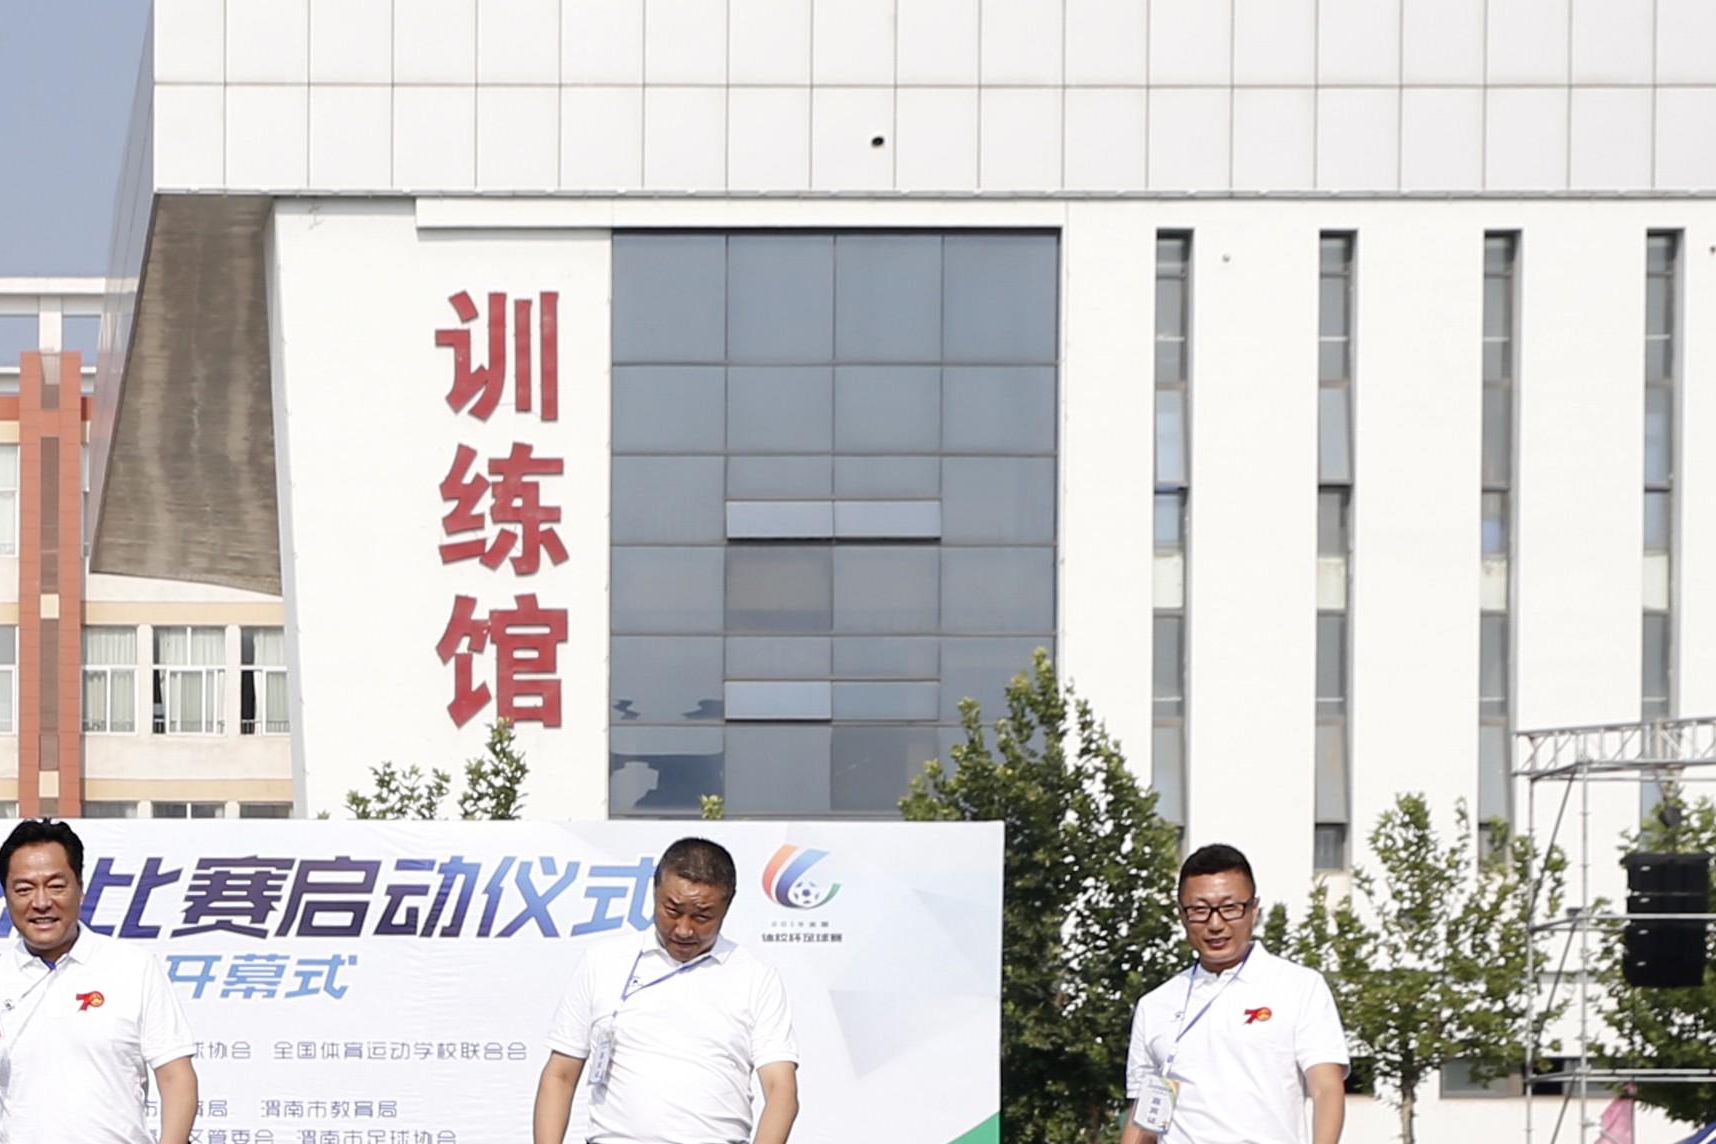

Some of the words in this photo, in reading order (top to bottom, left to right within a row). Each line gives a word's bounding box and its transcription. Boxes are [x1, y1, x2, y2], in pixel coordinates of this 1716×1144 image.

[435, 290, 569, 729] 训练馆
[273, 1041, 527, 1061] 全国体育运动学校联合会
[260, 1100, 398, 1119] 渭南市教育局
